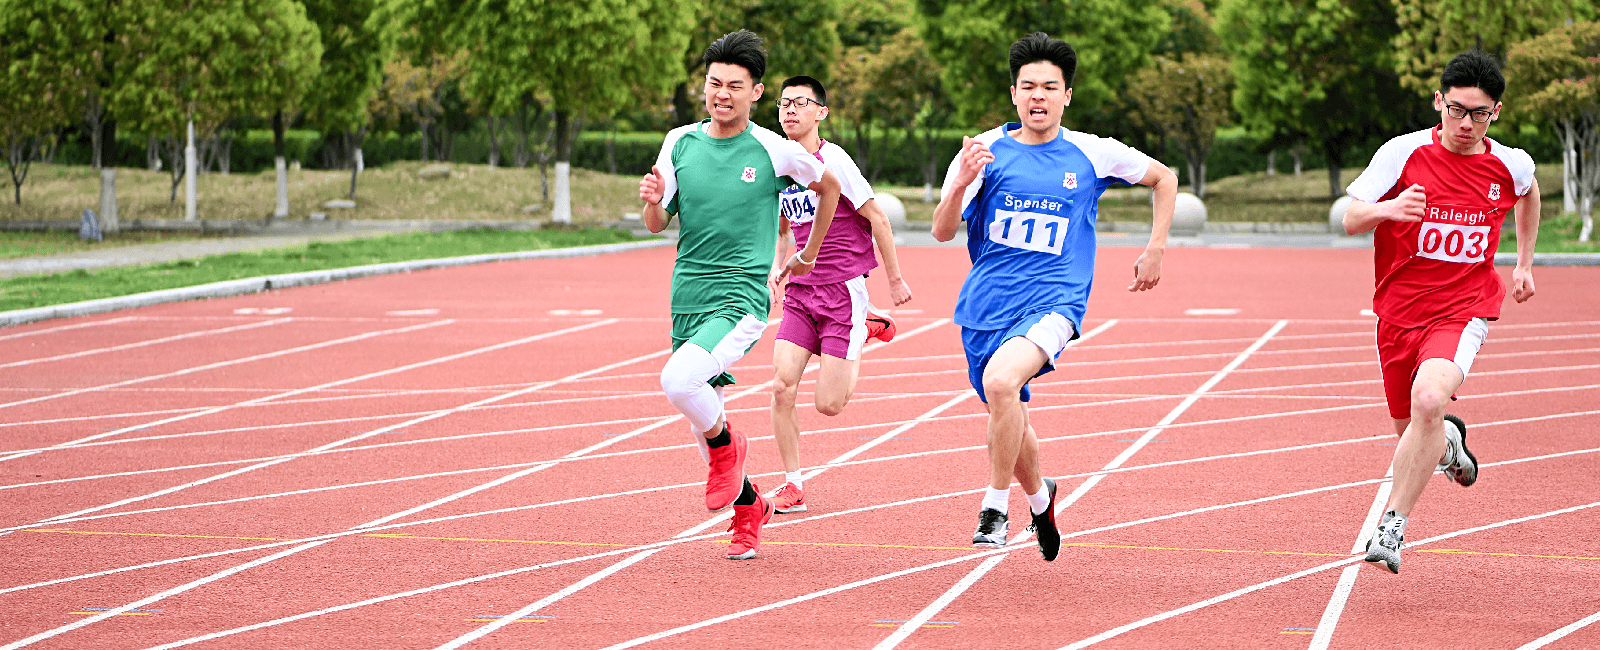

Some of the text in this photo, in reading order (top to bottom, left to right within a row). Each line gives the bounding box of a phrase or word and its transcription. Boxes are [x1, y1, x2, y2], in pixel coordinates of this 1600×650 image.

[782, 195, 815, 219] 004
[1004, 195, 1063, 211] Spenser
[1429, 206, 1486, 225] Raleigh
[1000, 216, 1059, 248] 111
[1423, 228, 1484, 258] 003
